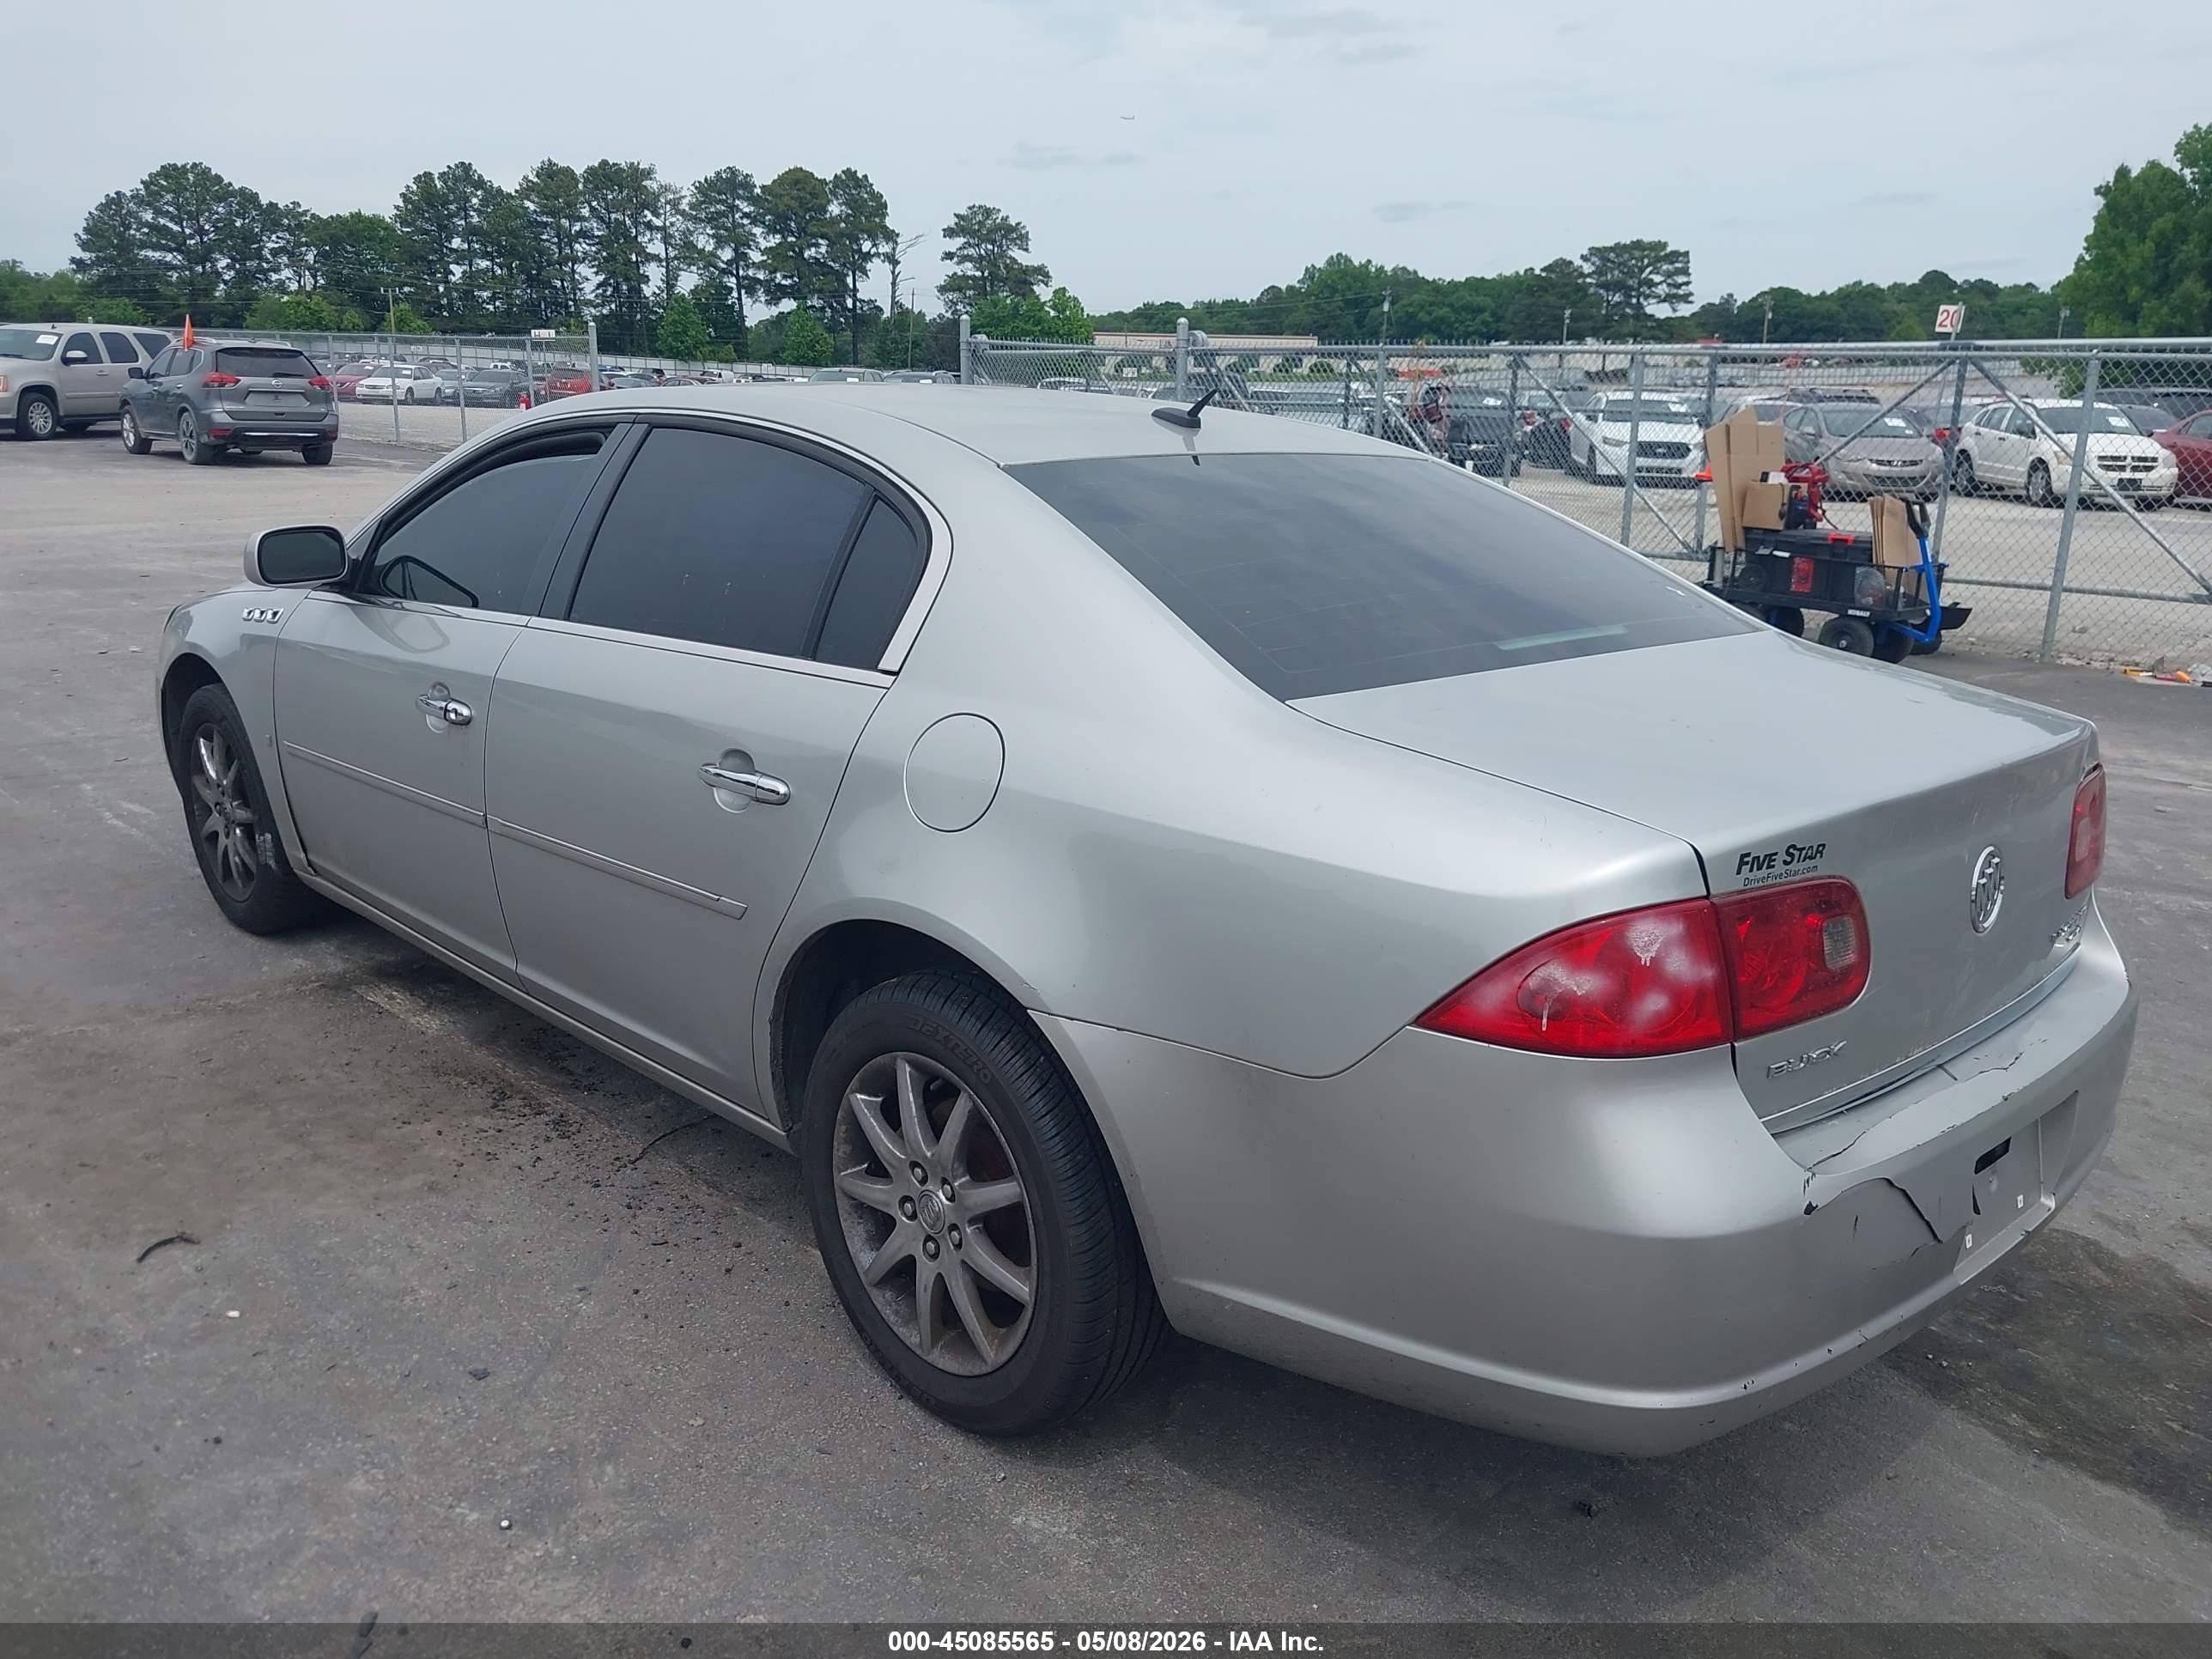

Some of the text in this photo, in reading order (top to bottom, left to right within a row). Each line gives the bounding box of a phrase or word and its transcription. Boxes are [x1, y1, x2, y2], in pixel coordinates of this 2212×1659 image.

[1735, 842, 1826, 876] FIVE STAR
[1743, 865, 1819, 887] DriveFiveStar.com
[1766, 1040, 1848, 1079] BUICK
